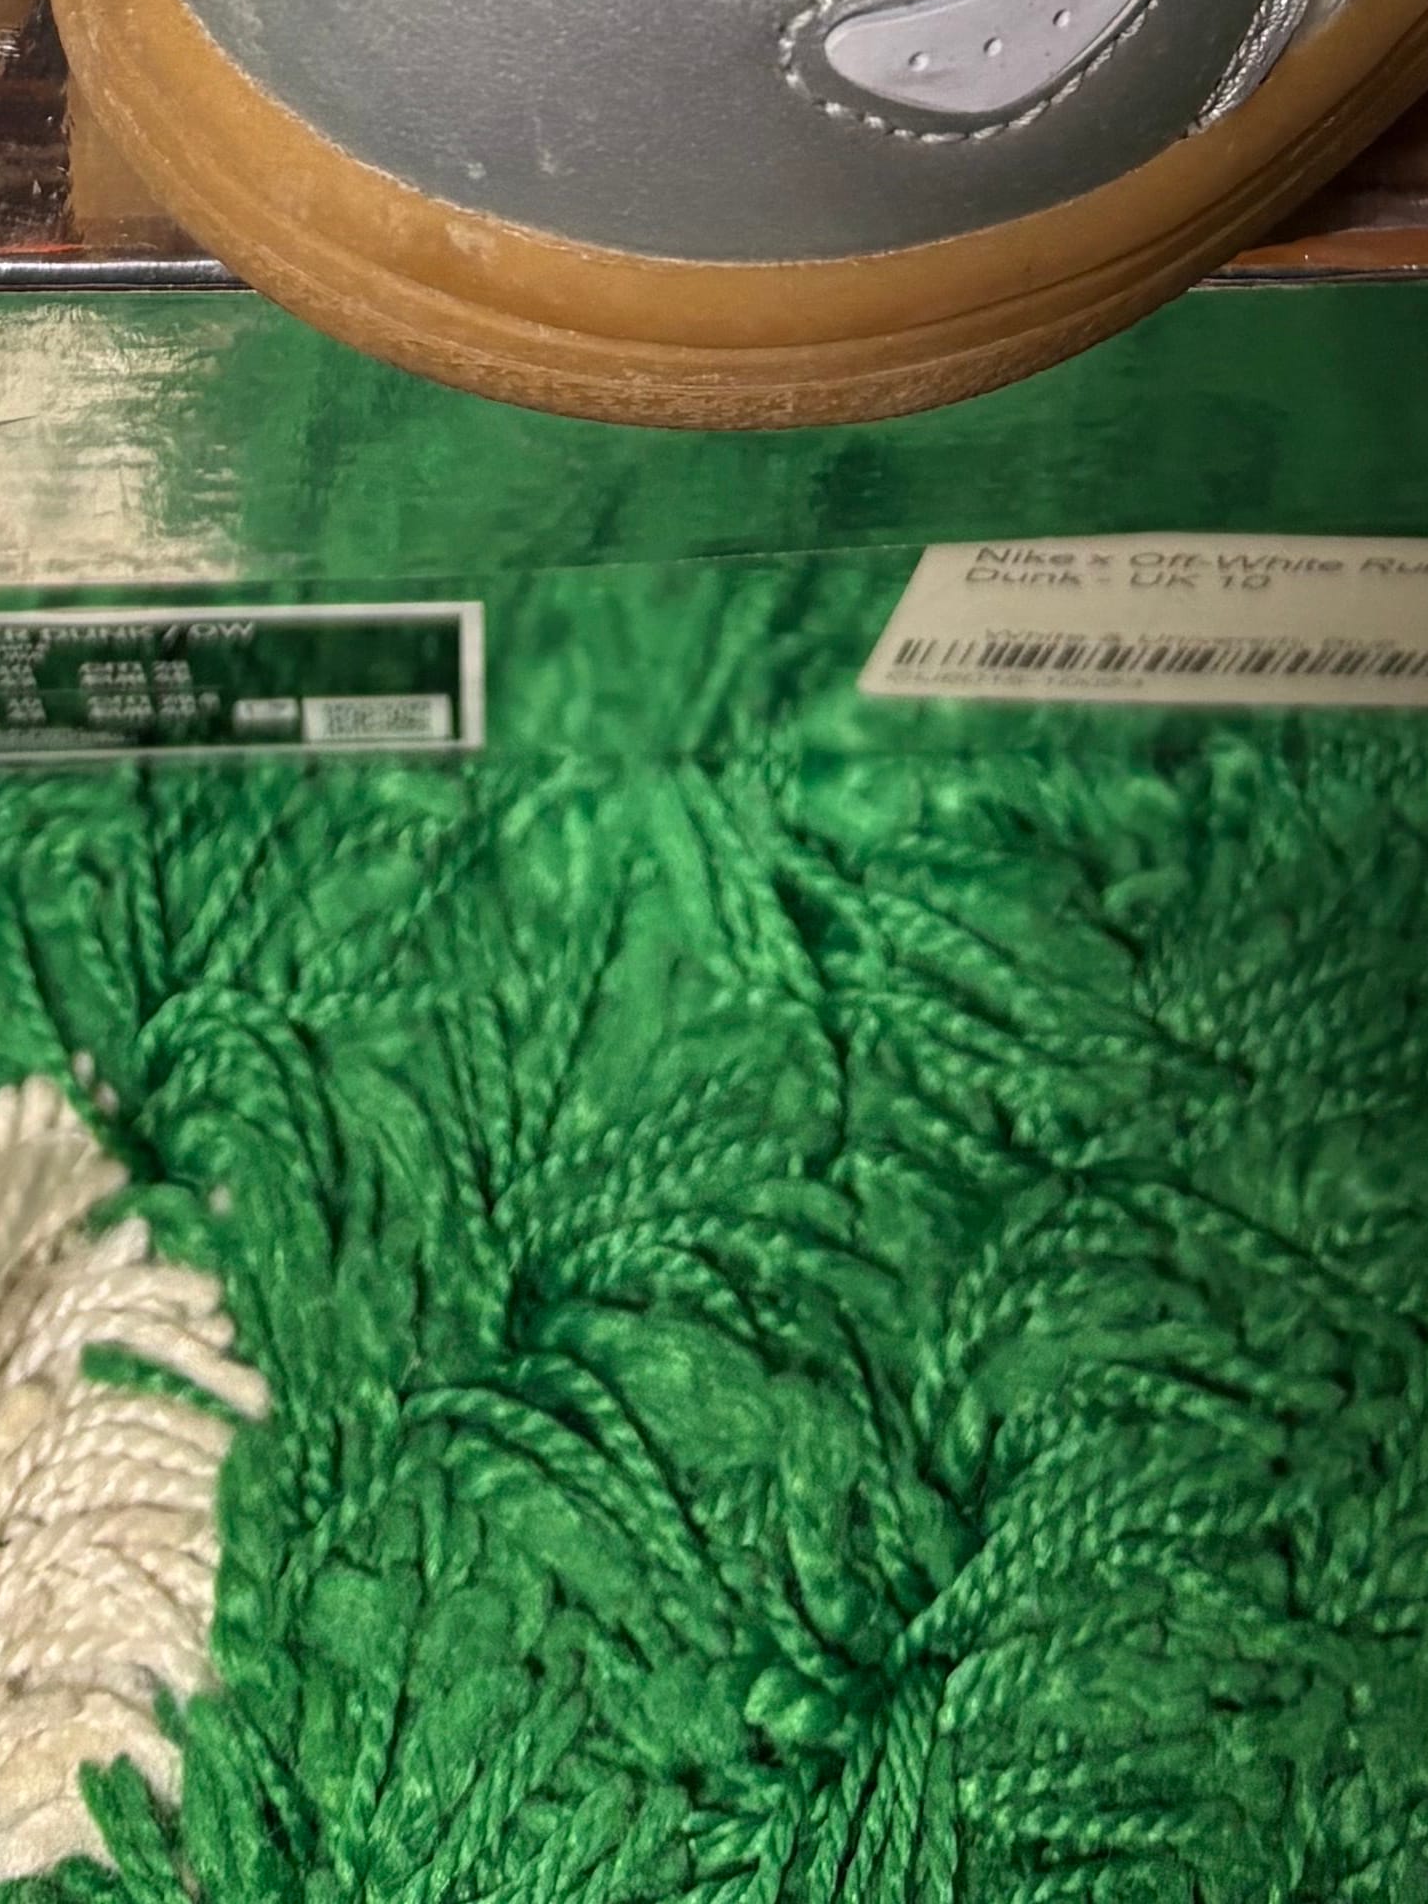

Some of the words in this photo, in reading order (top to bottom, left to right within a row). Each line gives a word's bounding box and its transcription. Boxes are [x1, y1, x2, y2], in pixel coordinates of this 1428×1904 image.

[977, 547, 1075, 566] Nike
[1129, 552, 1344, 572] Off-White
[966, 567, 1081, 586] Dunk
[1129, 571, 1198, 588] UK
[1220, 574, 1271, 591] 10
